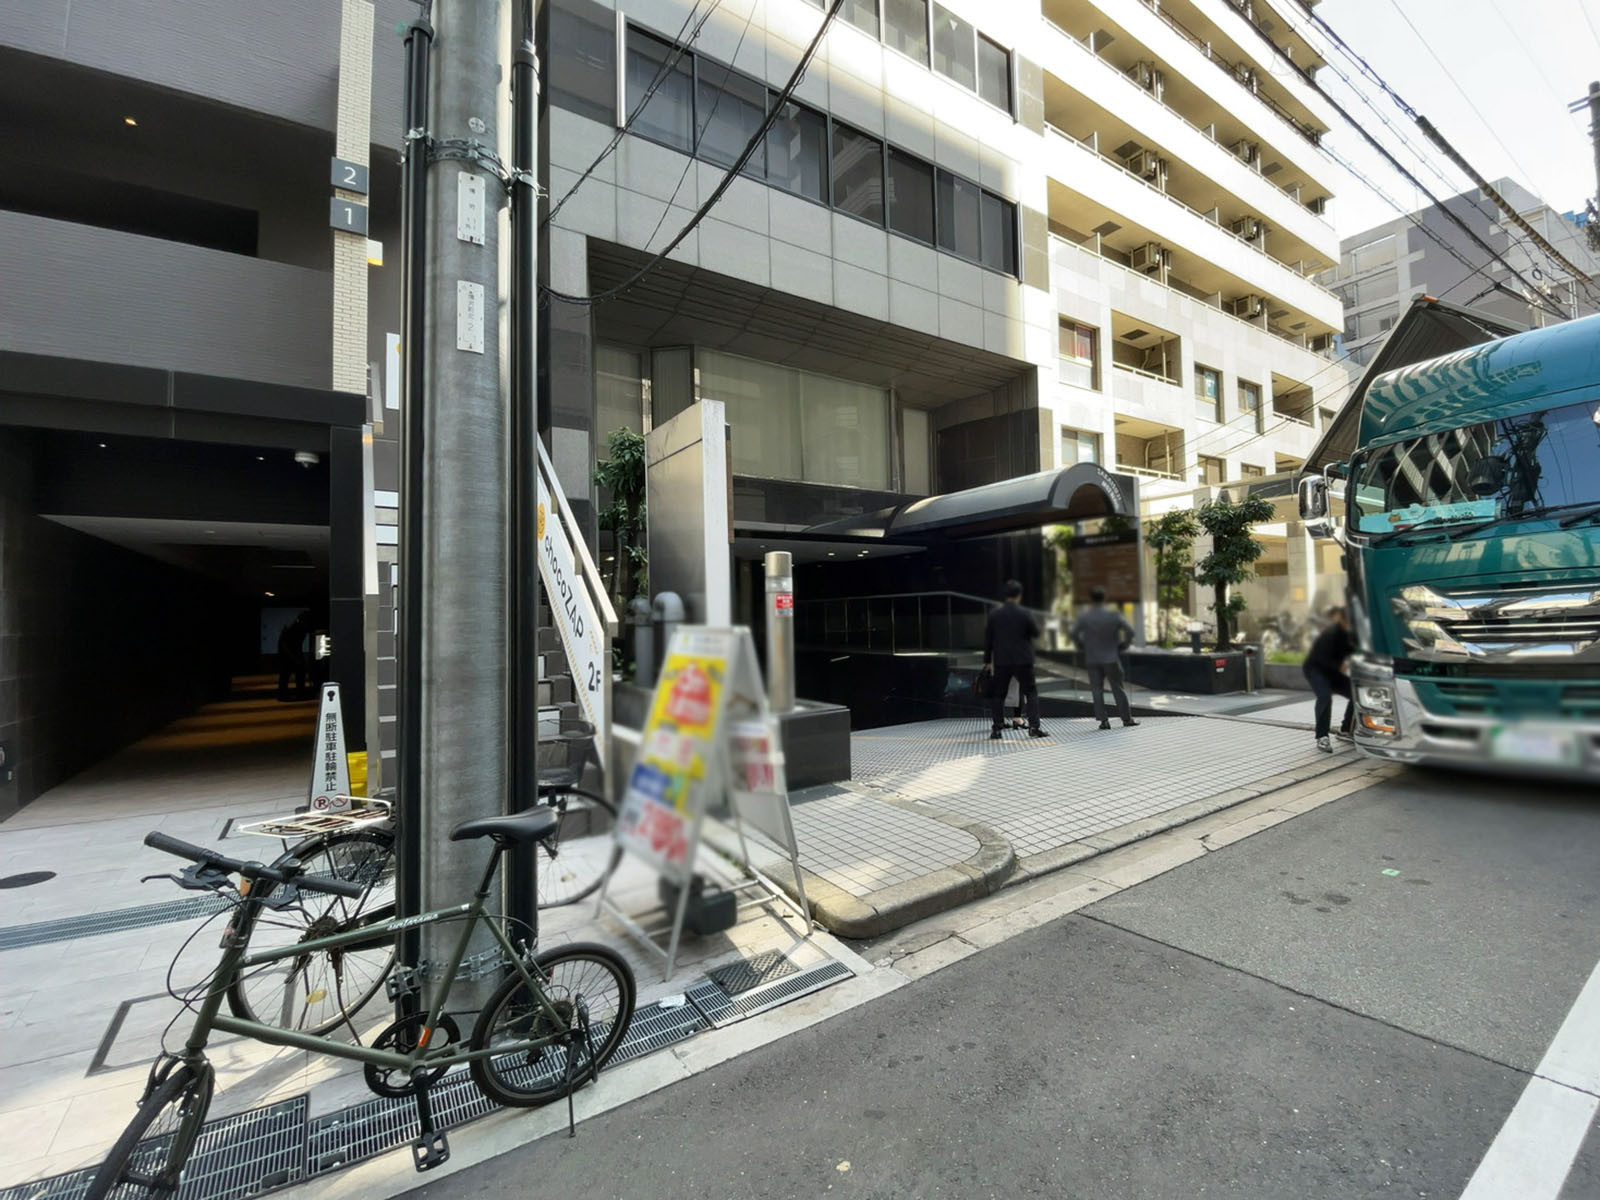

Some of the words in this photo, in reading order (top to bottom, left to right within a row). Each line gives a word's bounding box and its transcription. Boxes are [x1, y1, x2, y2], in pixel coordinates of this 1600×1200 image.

[344, 166, 356, 185] 2
[344, 207, 352, 225] 1
[545, 535, 584, 639] chocoZAP
[588, 661, 601, 693] 2F
[325, 712, 337, 792] 無断駐車駐輪禁止
